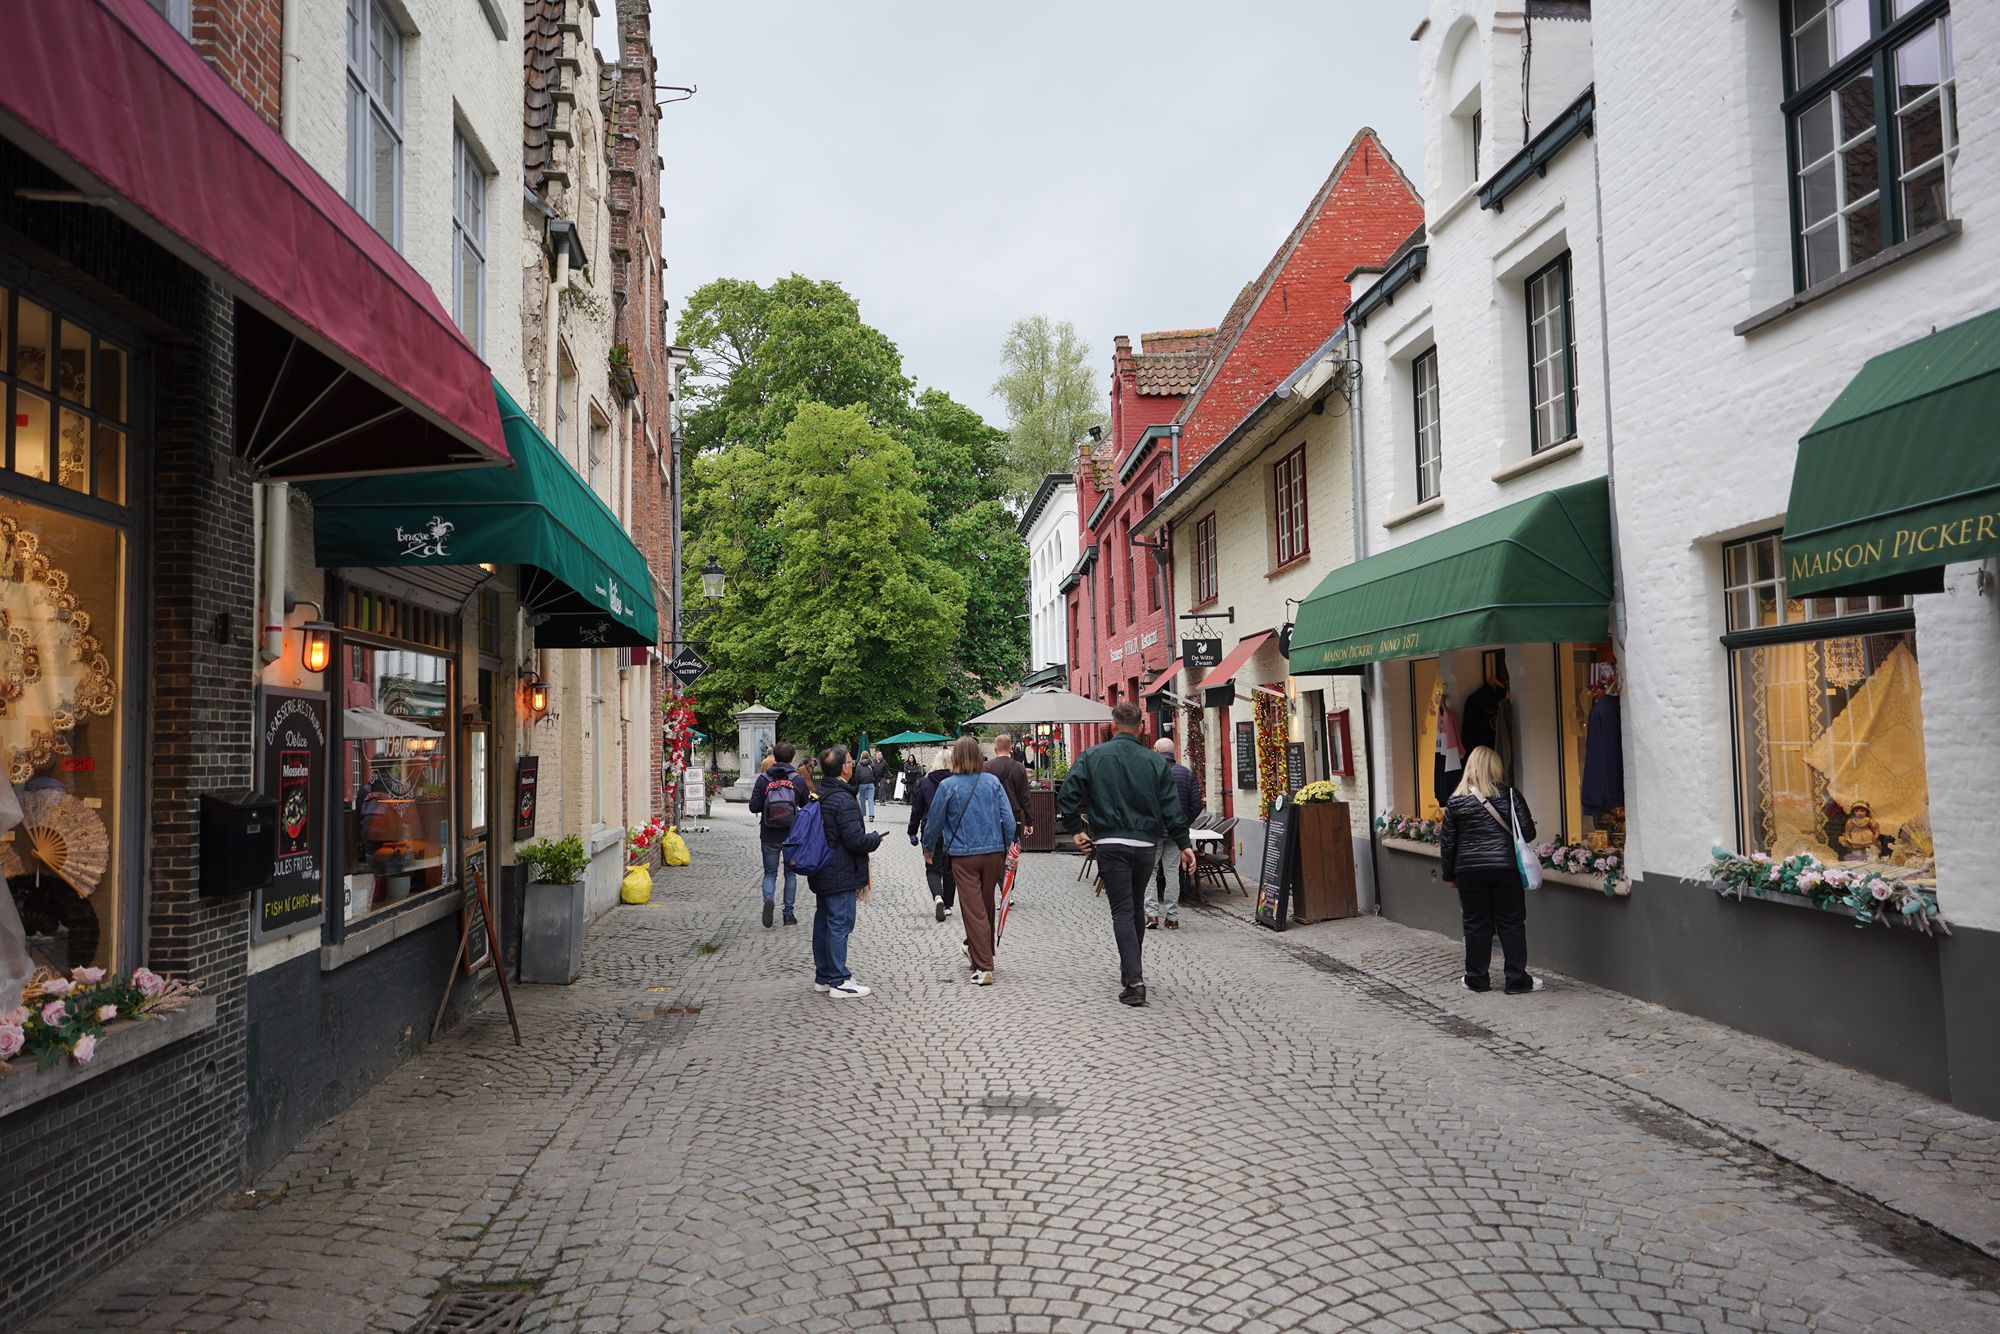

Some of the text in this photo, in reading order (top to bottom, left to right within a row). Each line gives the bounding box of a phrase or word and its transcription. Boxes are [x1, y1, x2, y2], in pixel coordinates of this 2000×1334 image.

[400, 542, 452, 558] Zot
[1791, 538, 1884, 582] MAISON
[1322, 632, 1420, 662] MAISON PICKERY ANNO 1871
[672, 658, 703, 669] Chocolate
[285, 730, 308, 748] Délice
[282, 763, 309, 778] Mosselen
[293, 855, 313, 872] FRITES
[264, 899, 283, 919] FISH
[291, 893, 310, 912] CHIPS
